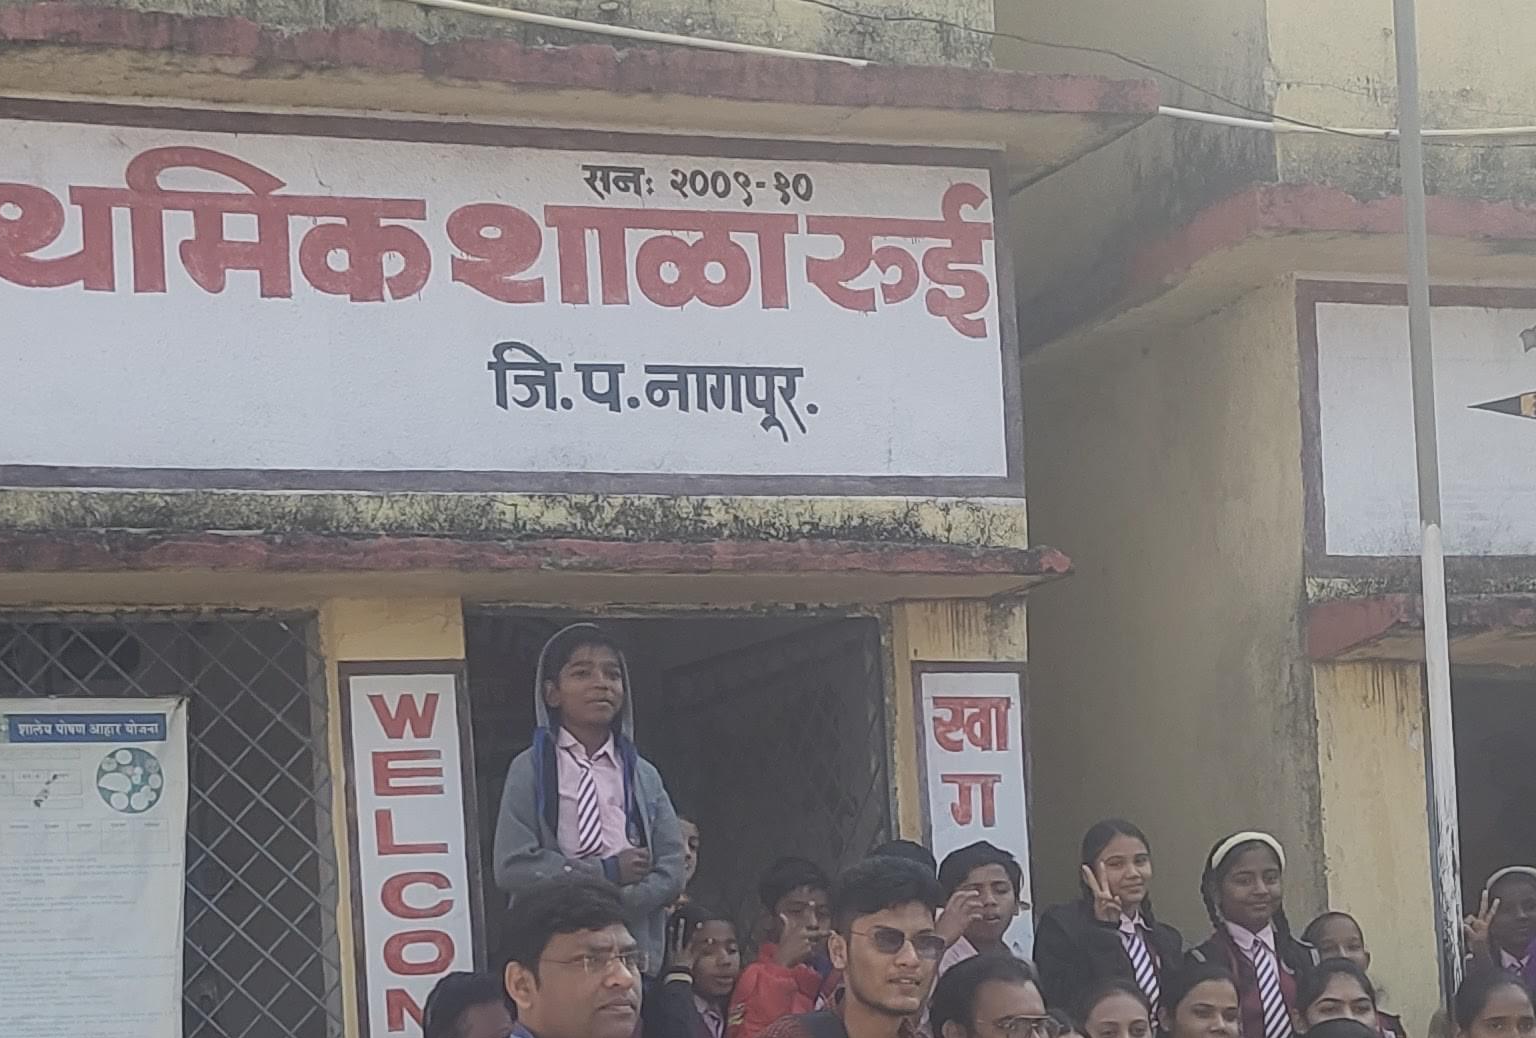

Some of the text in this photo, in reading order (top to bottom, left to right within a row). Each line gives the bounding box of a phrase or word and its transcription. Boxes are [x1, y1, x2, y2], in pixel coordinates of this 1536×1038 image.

[447, 202, 796, 311] शाळा
[804, 182, 993, 338] रुई
[18, 720, 159, 737] शालेय पोषण आहार योजना
